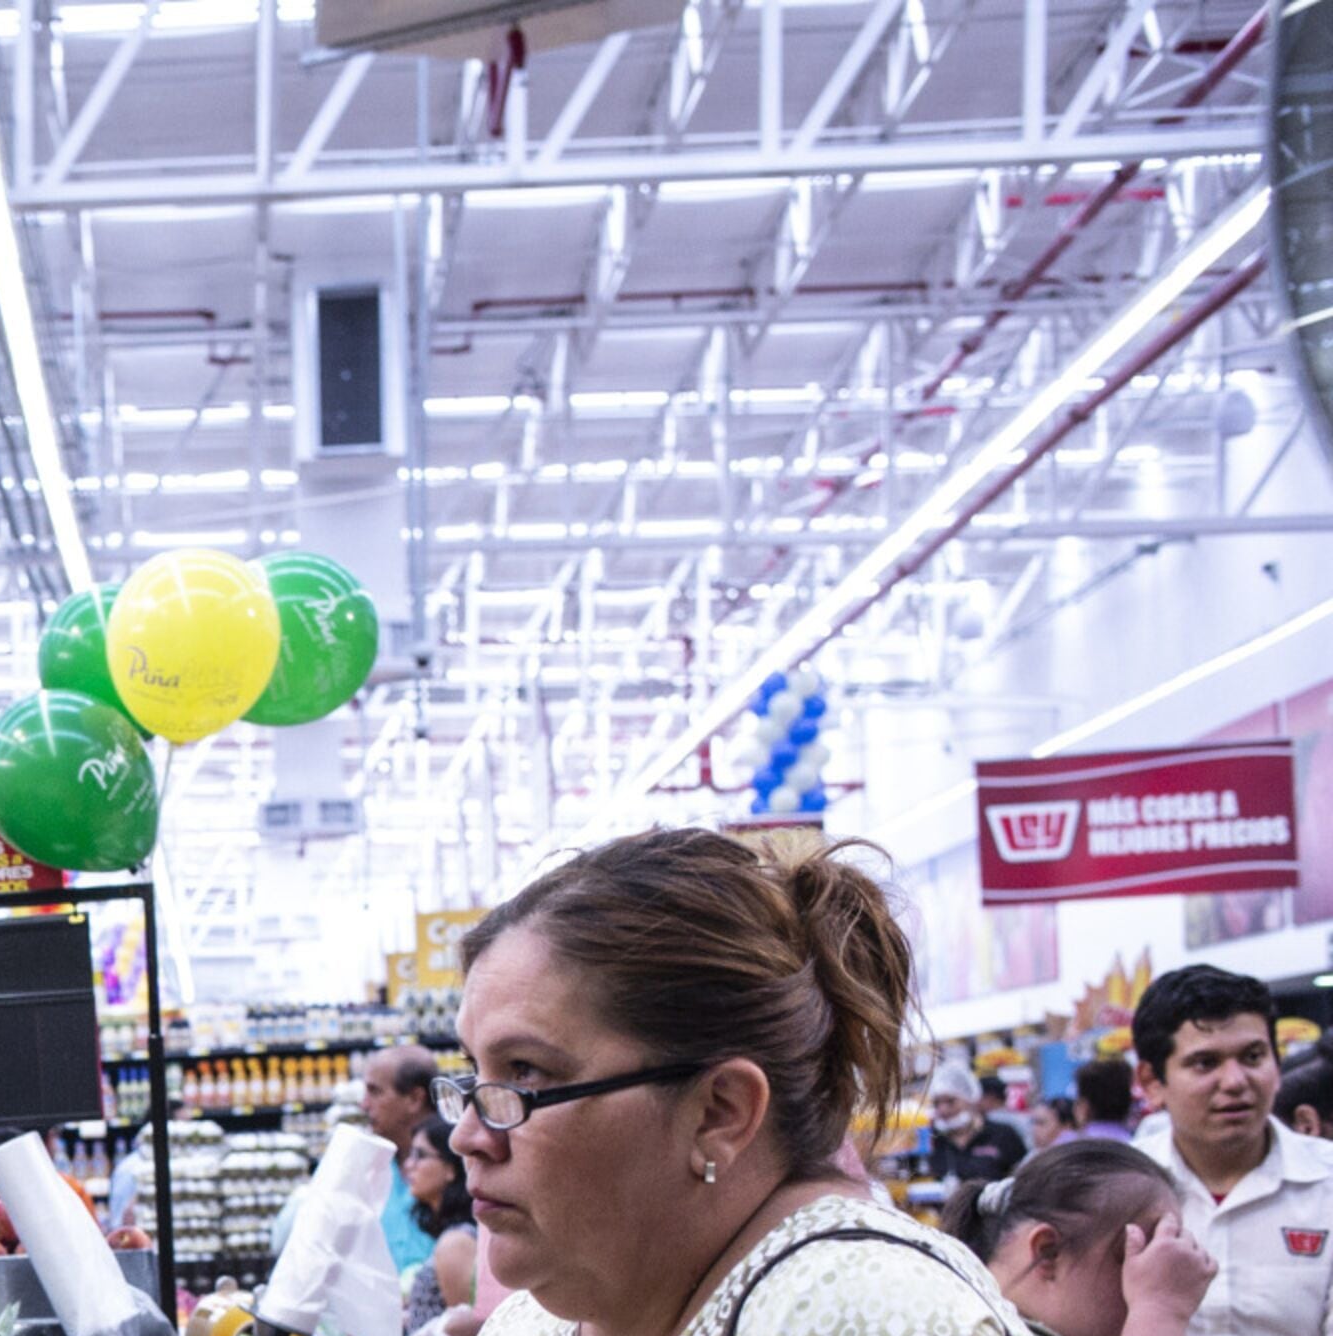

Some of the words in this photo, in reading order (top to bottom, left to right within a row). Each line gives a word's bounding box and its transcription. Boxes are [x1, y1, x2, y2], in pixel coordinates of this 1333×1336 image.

[127, 645, 181, 688] Piña
[1087, 794, 1139, 826] MÁS
[1141, 791, 1217, 824] COSAS
[1219, 788, 1240, 818] A
[1088, 824, 1189, 858] MEJORES
[1190, 815, 1292, 850] PRECIOS
